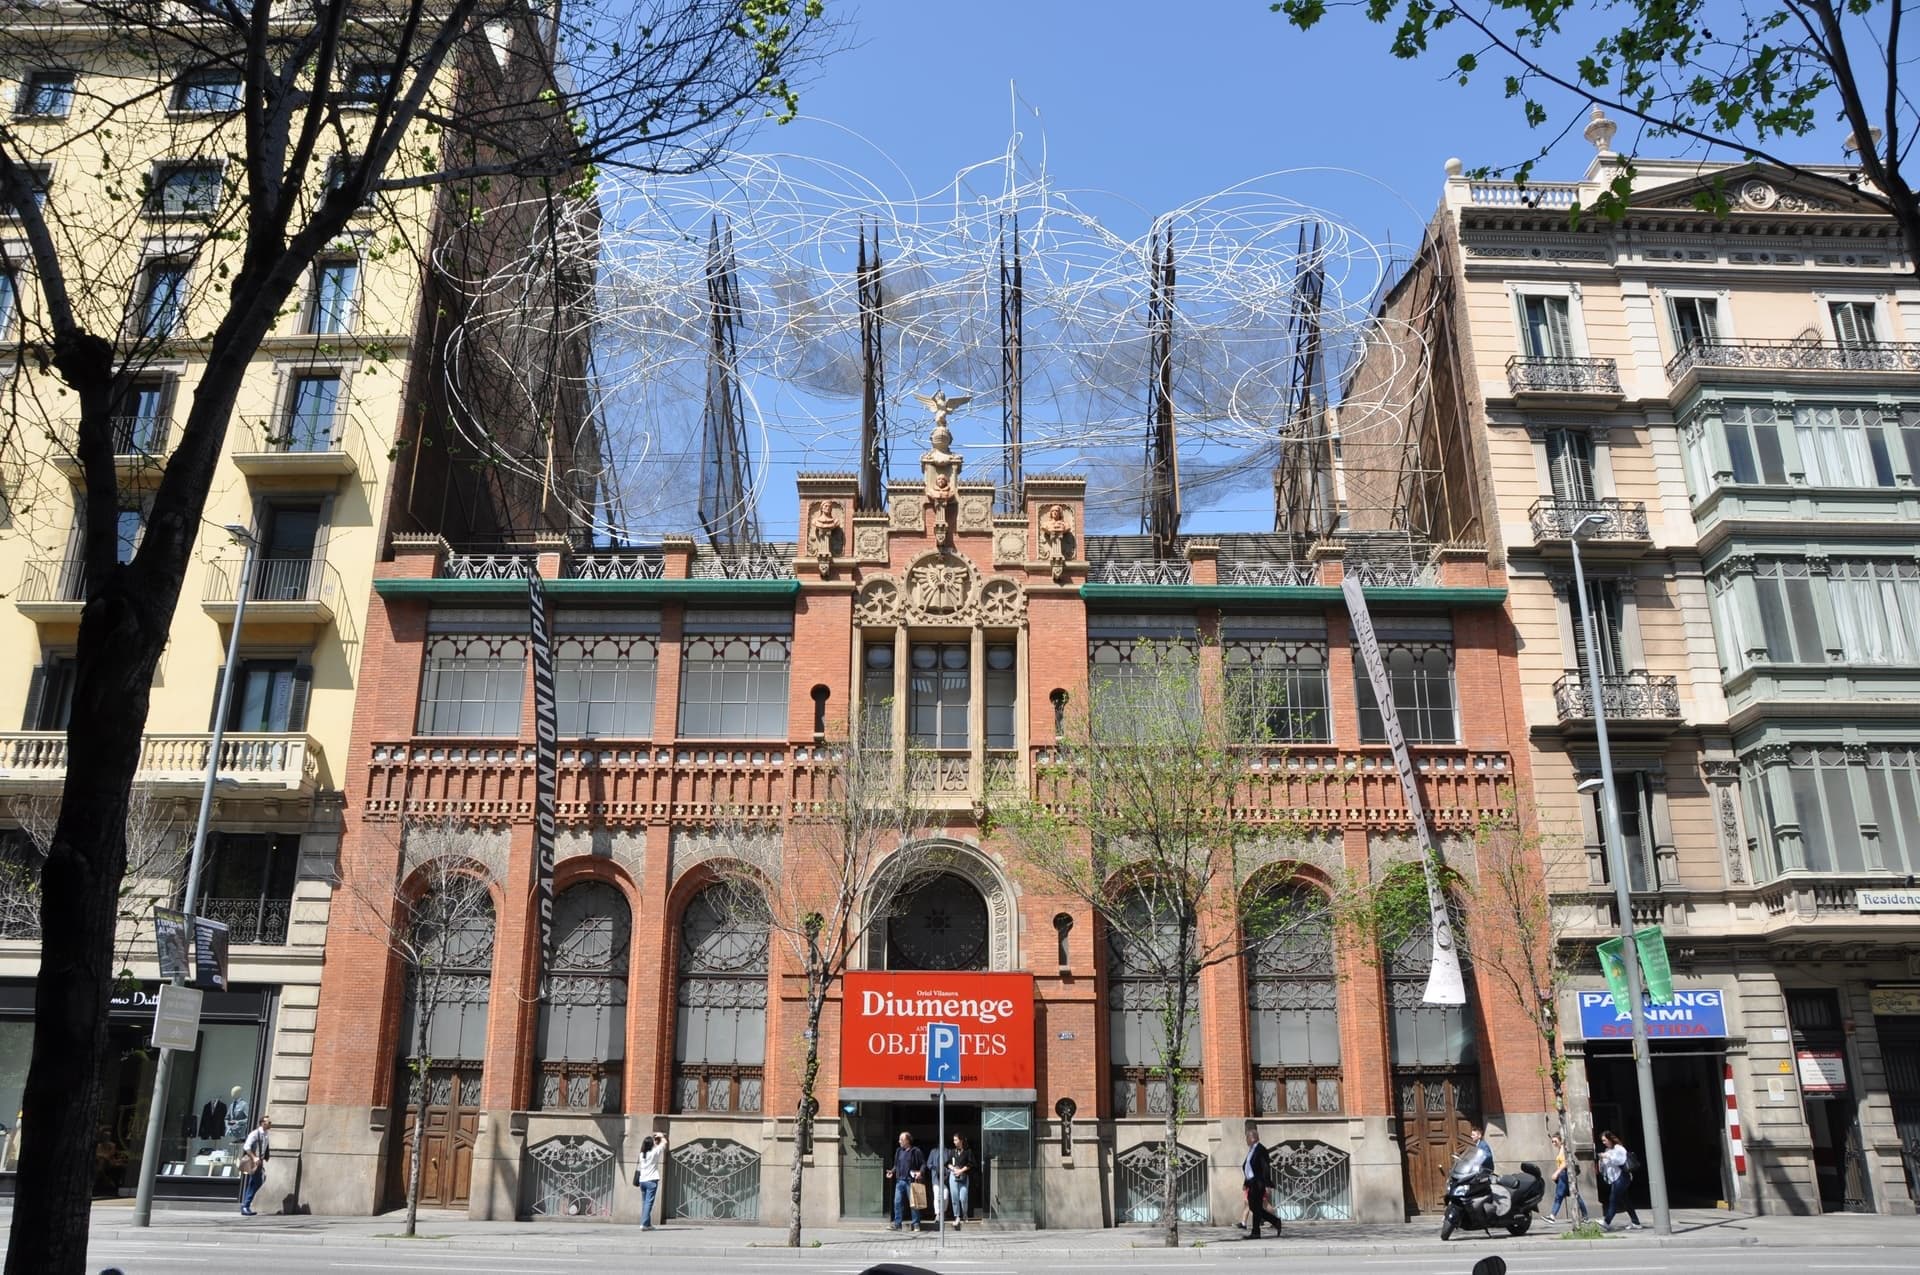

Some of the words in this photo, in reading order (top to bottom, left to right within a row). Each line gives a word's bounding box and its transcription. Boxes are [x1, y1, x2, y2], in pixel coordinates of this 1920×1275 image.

[861, 990, 1014, 1024] Diumenge
[1583, 992, 1720, 1008] PANG
[1615, 1009, 1693, 1021] ANMI
[1602, 1024, 1709, 1037] SOTIDA
[868, 1032, 1007, 1056] OBJTES
[934, 1028, 954, 1059] P
